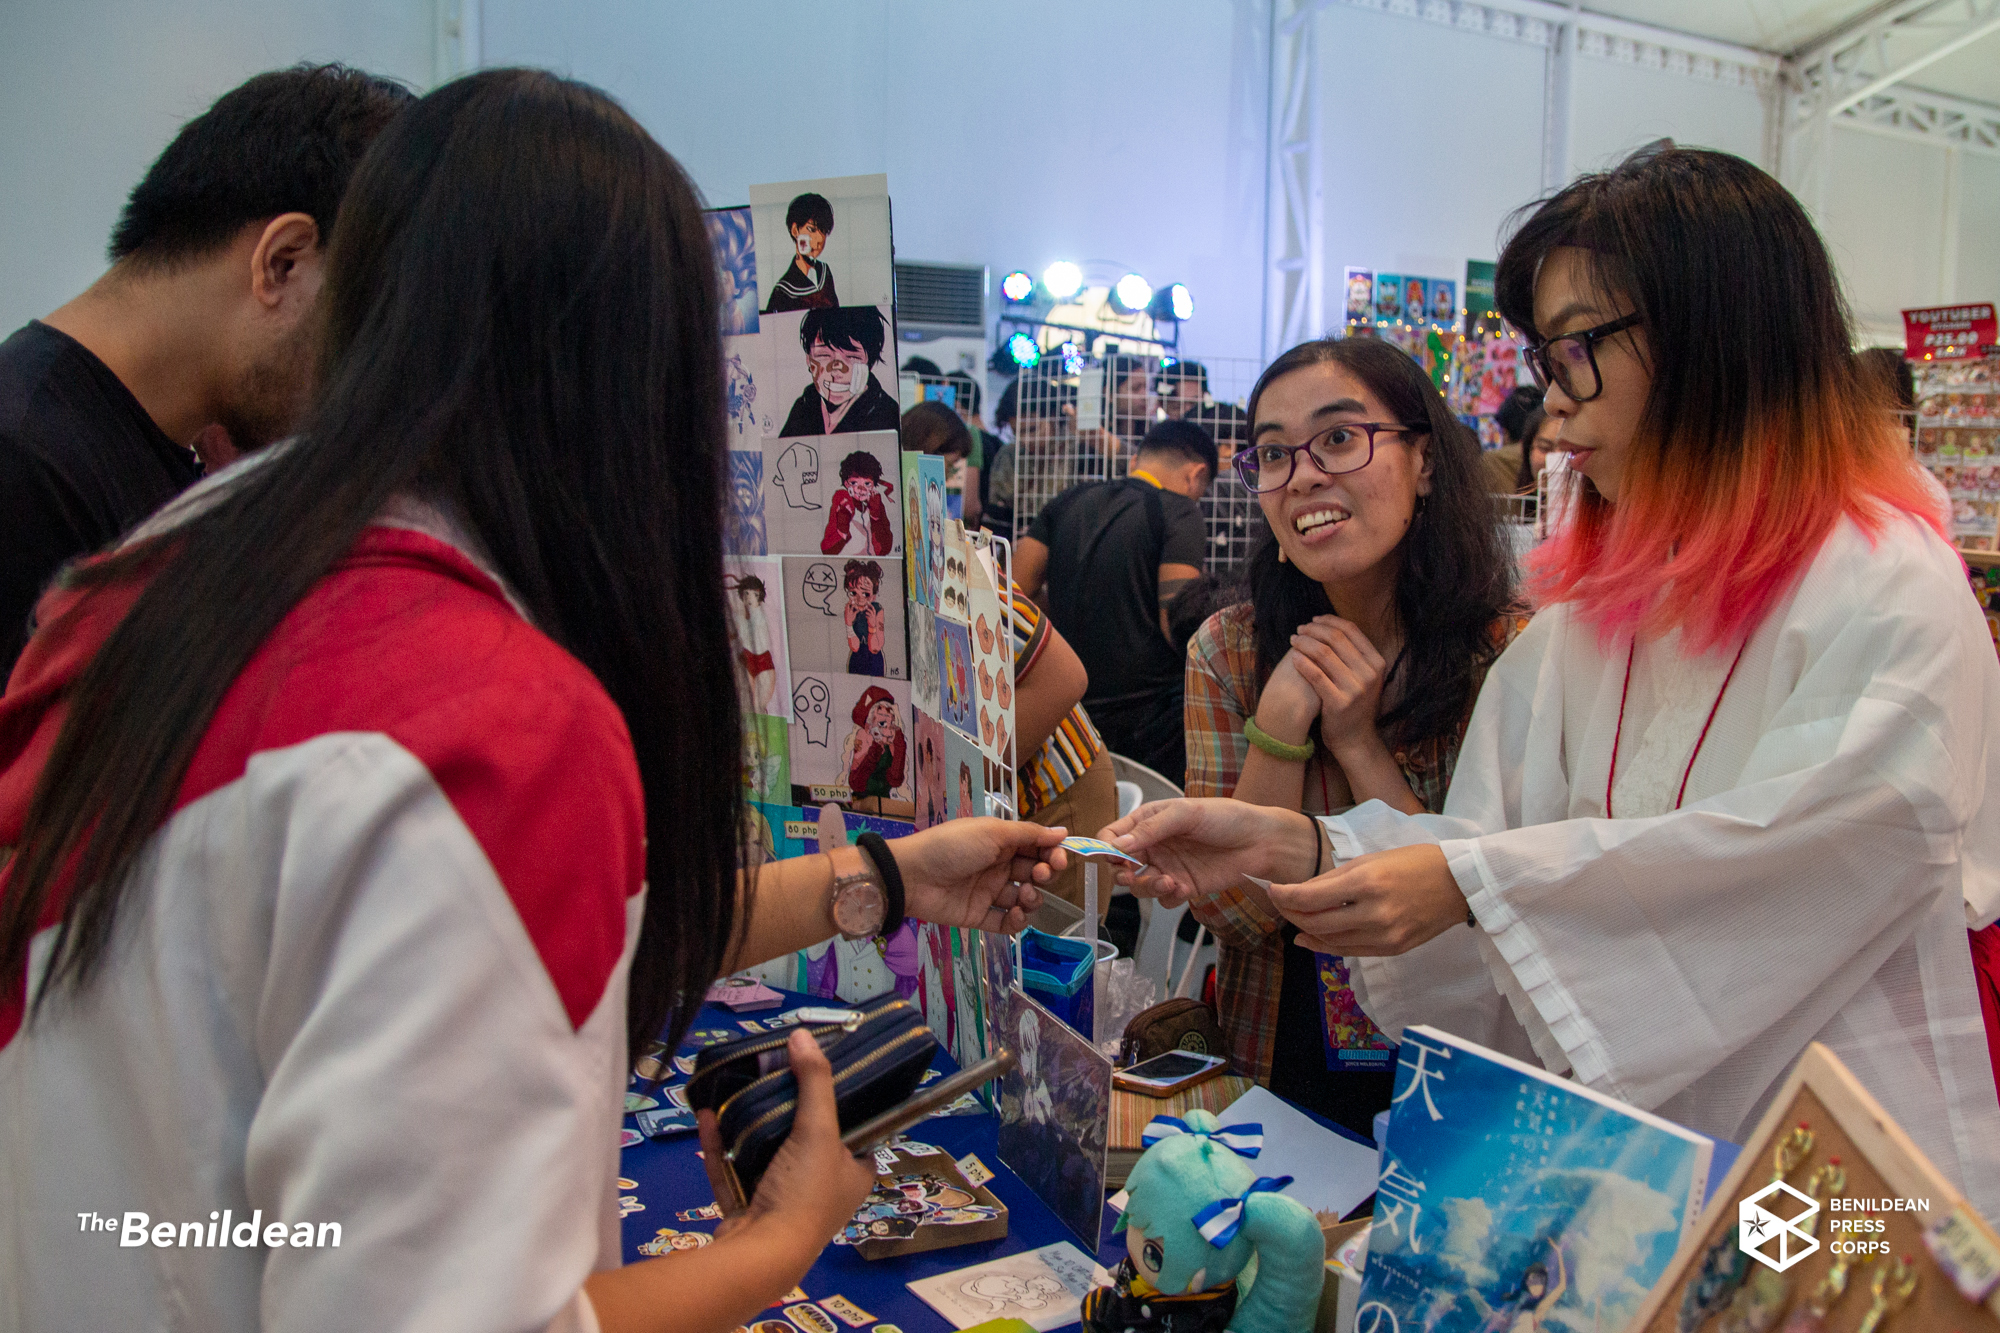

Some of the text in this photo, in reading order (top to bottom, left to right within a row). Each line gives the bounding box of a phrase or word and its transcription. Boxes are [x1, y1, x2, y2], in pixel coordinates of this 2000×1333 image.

[1910, 307, 1990, 323] YOUTUBER
[814, 788, 848, 799] 50 php
[802, 825, 818, 835] php
[876, 1149, 893, 1161] EEP
[965, 1161, 985, 1183] 5 php
[830, 1299, 864, 1323] 10 php
